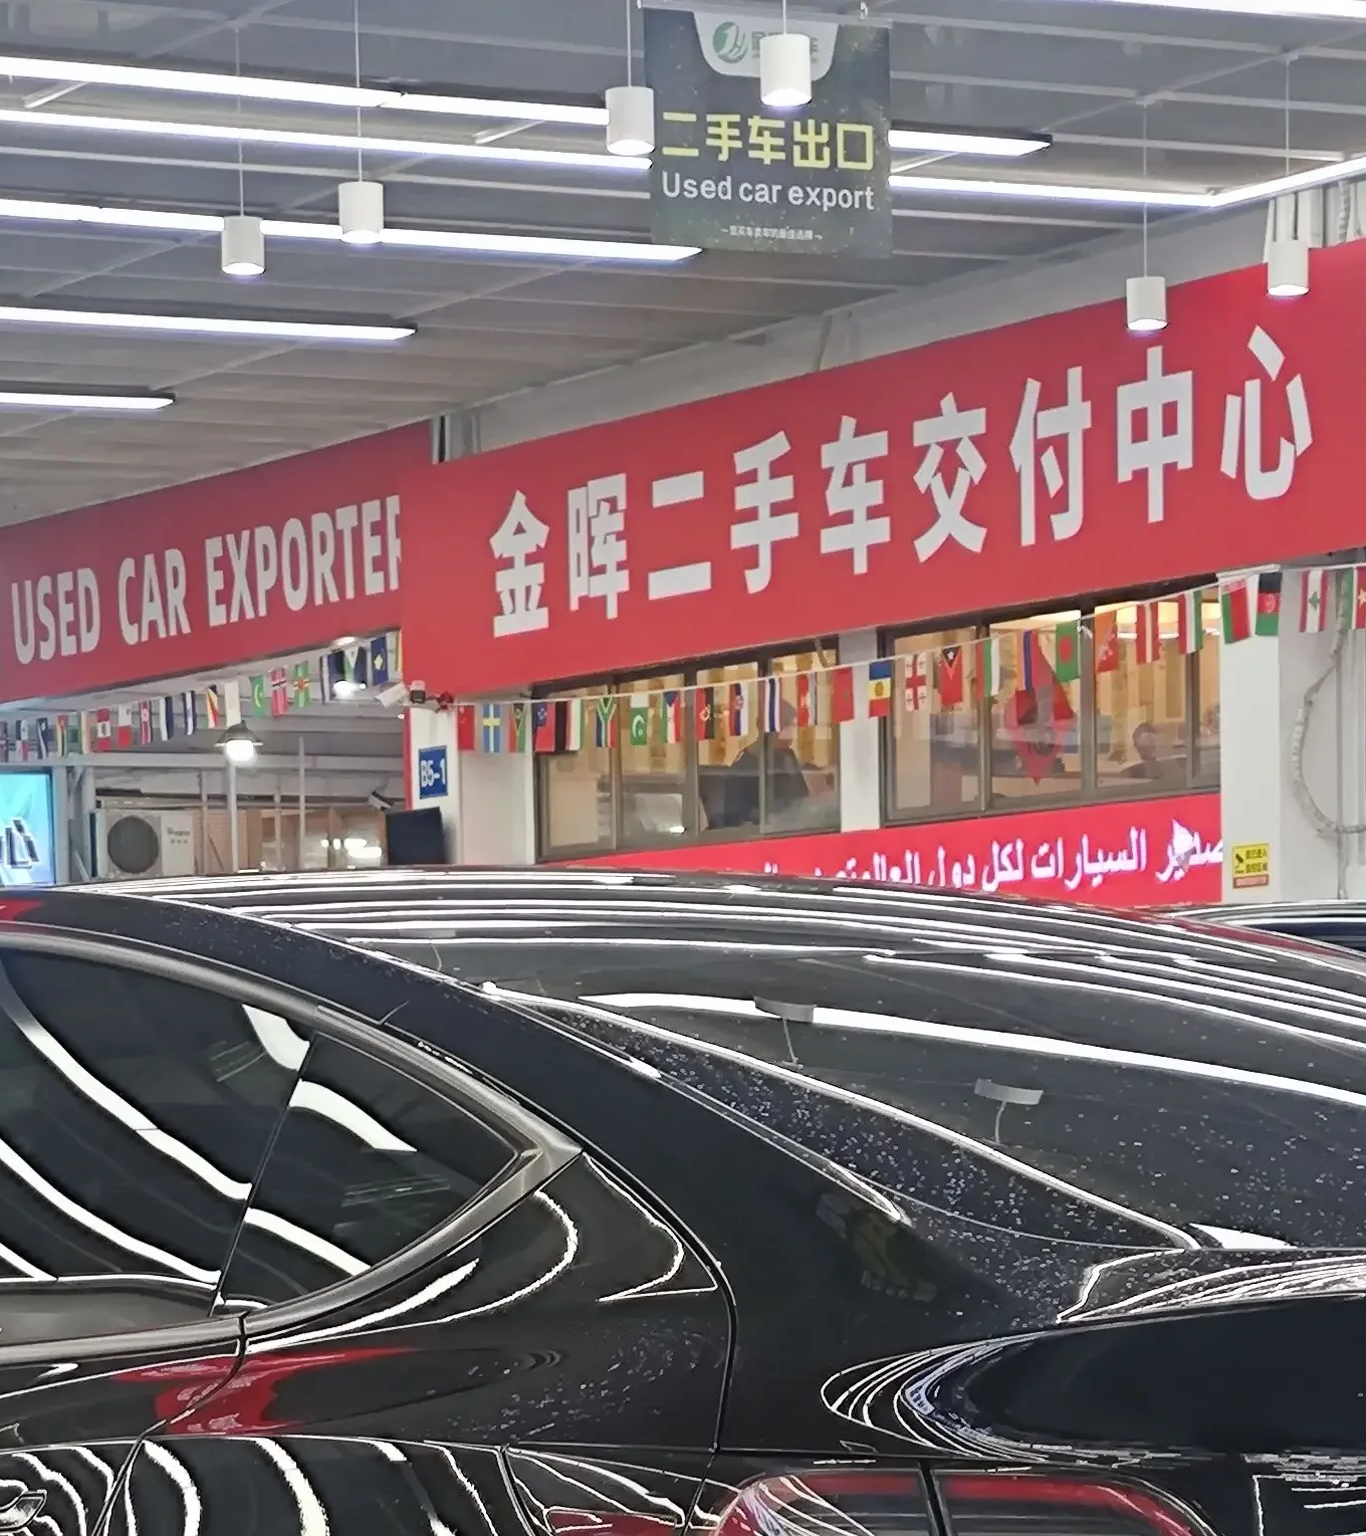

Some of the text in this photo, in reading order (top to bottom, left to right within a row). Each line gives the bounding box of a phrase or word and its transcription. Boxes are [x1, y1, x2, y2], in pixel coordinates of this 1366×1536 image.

[662, 112, 874, 170] 二手车出口
[662, 171, 875, 212] Used car export
[488, 324, 1315, 640] 金晖二手车交付中心
[11, 567, 101, 665] USED
[118, 548, 192, 646] CAR
[420, 758, 446, 788] B5-1
[1031, 826, 1148, 890] السيارات
